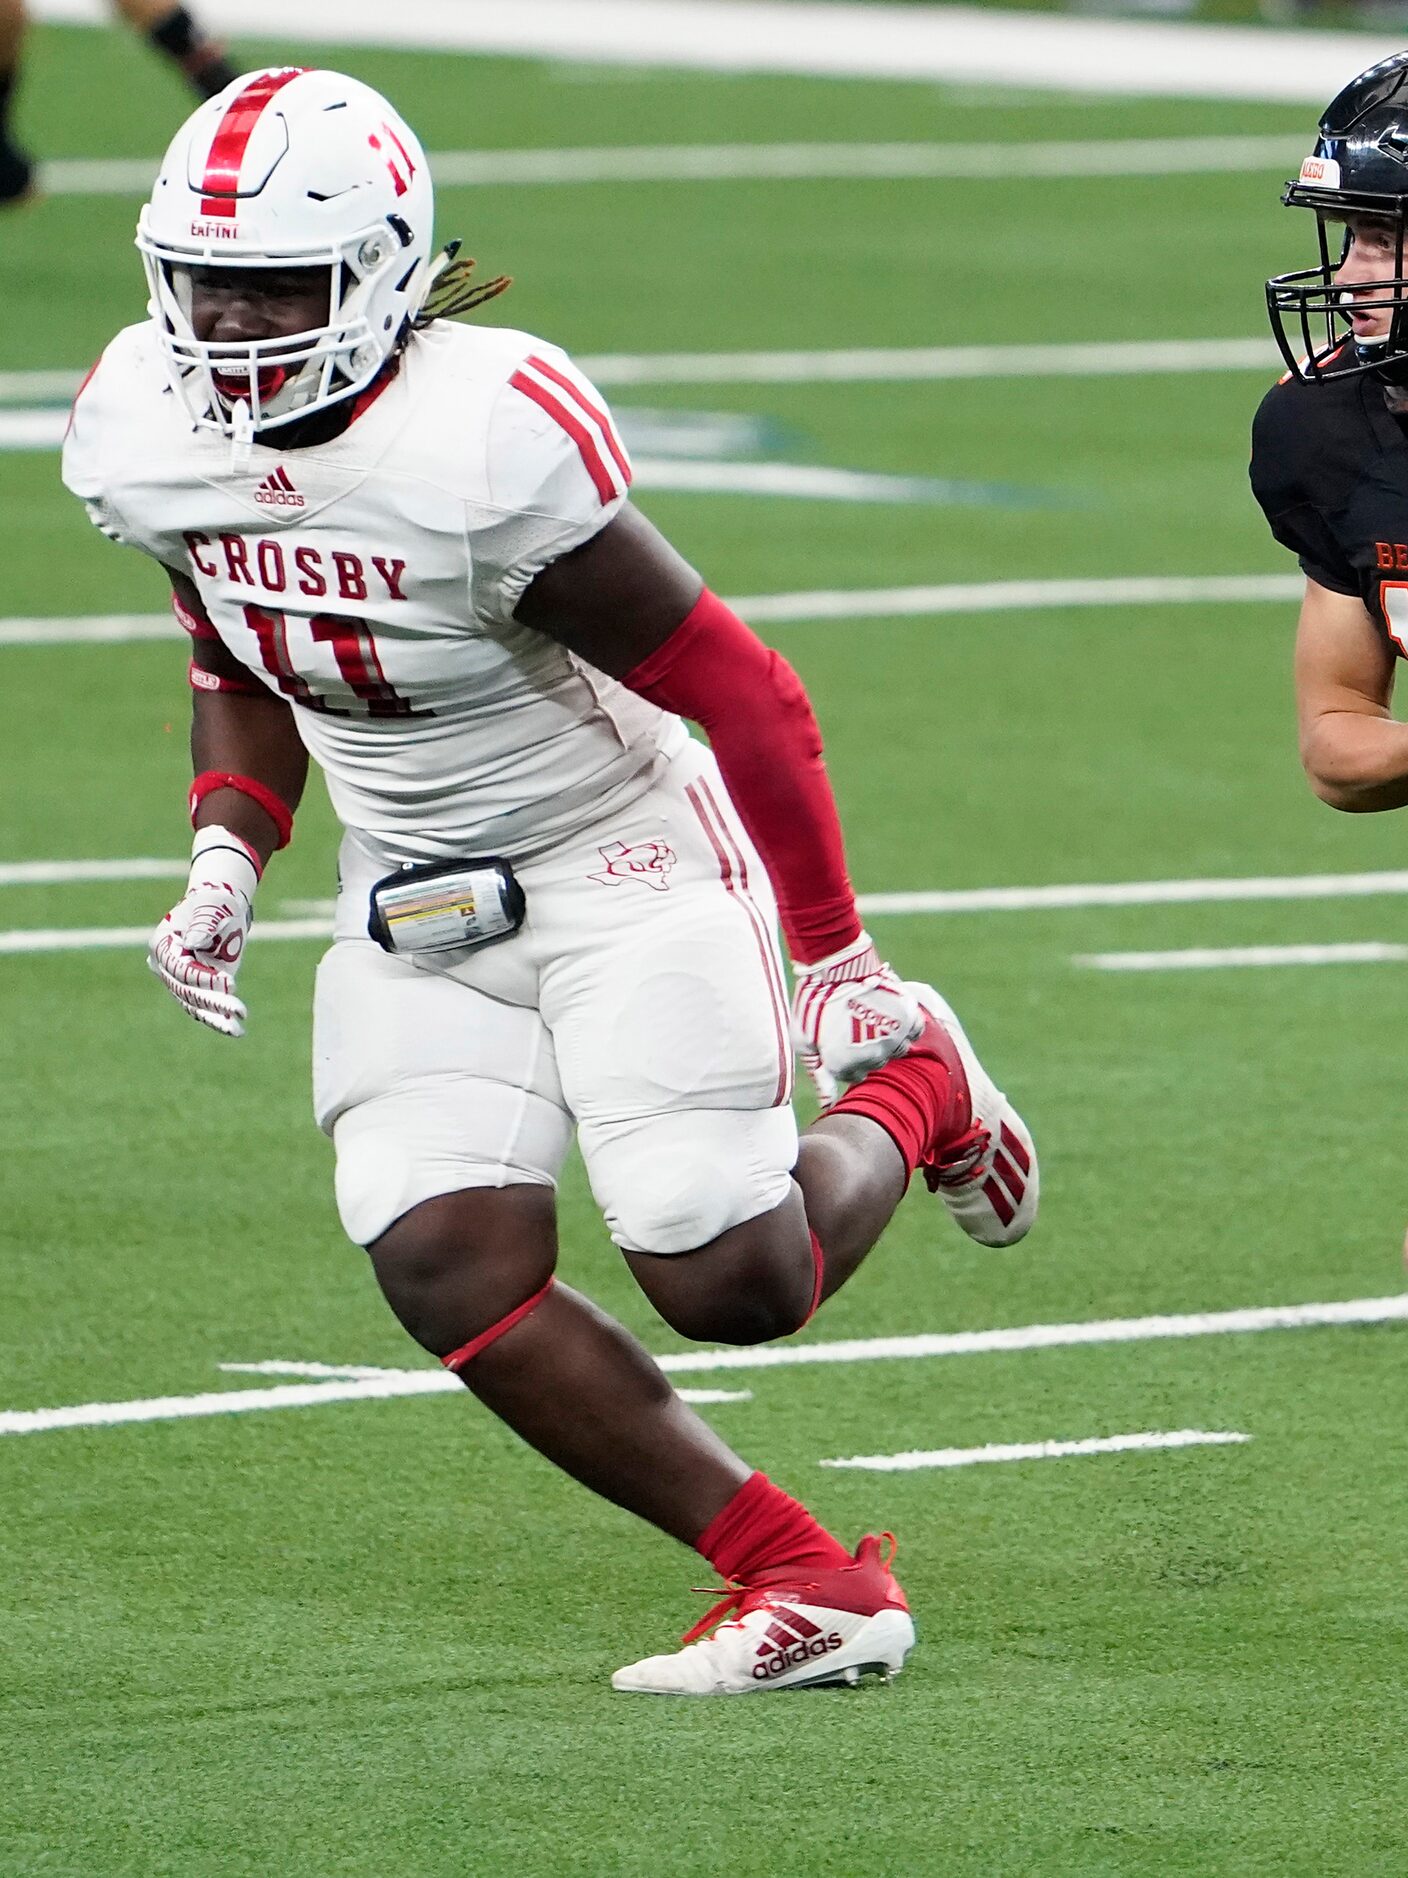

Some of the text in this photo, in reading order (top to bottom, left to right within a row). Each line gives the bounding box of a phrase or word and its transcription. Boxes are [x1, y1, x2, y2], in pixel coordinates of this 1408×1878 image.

[254, 489, 305, 507] adidas
[183, 531, 407, 600] CROSBY
[243, 603, 437, 717] 11
[753, 1632, 842, 1680] adidas
